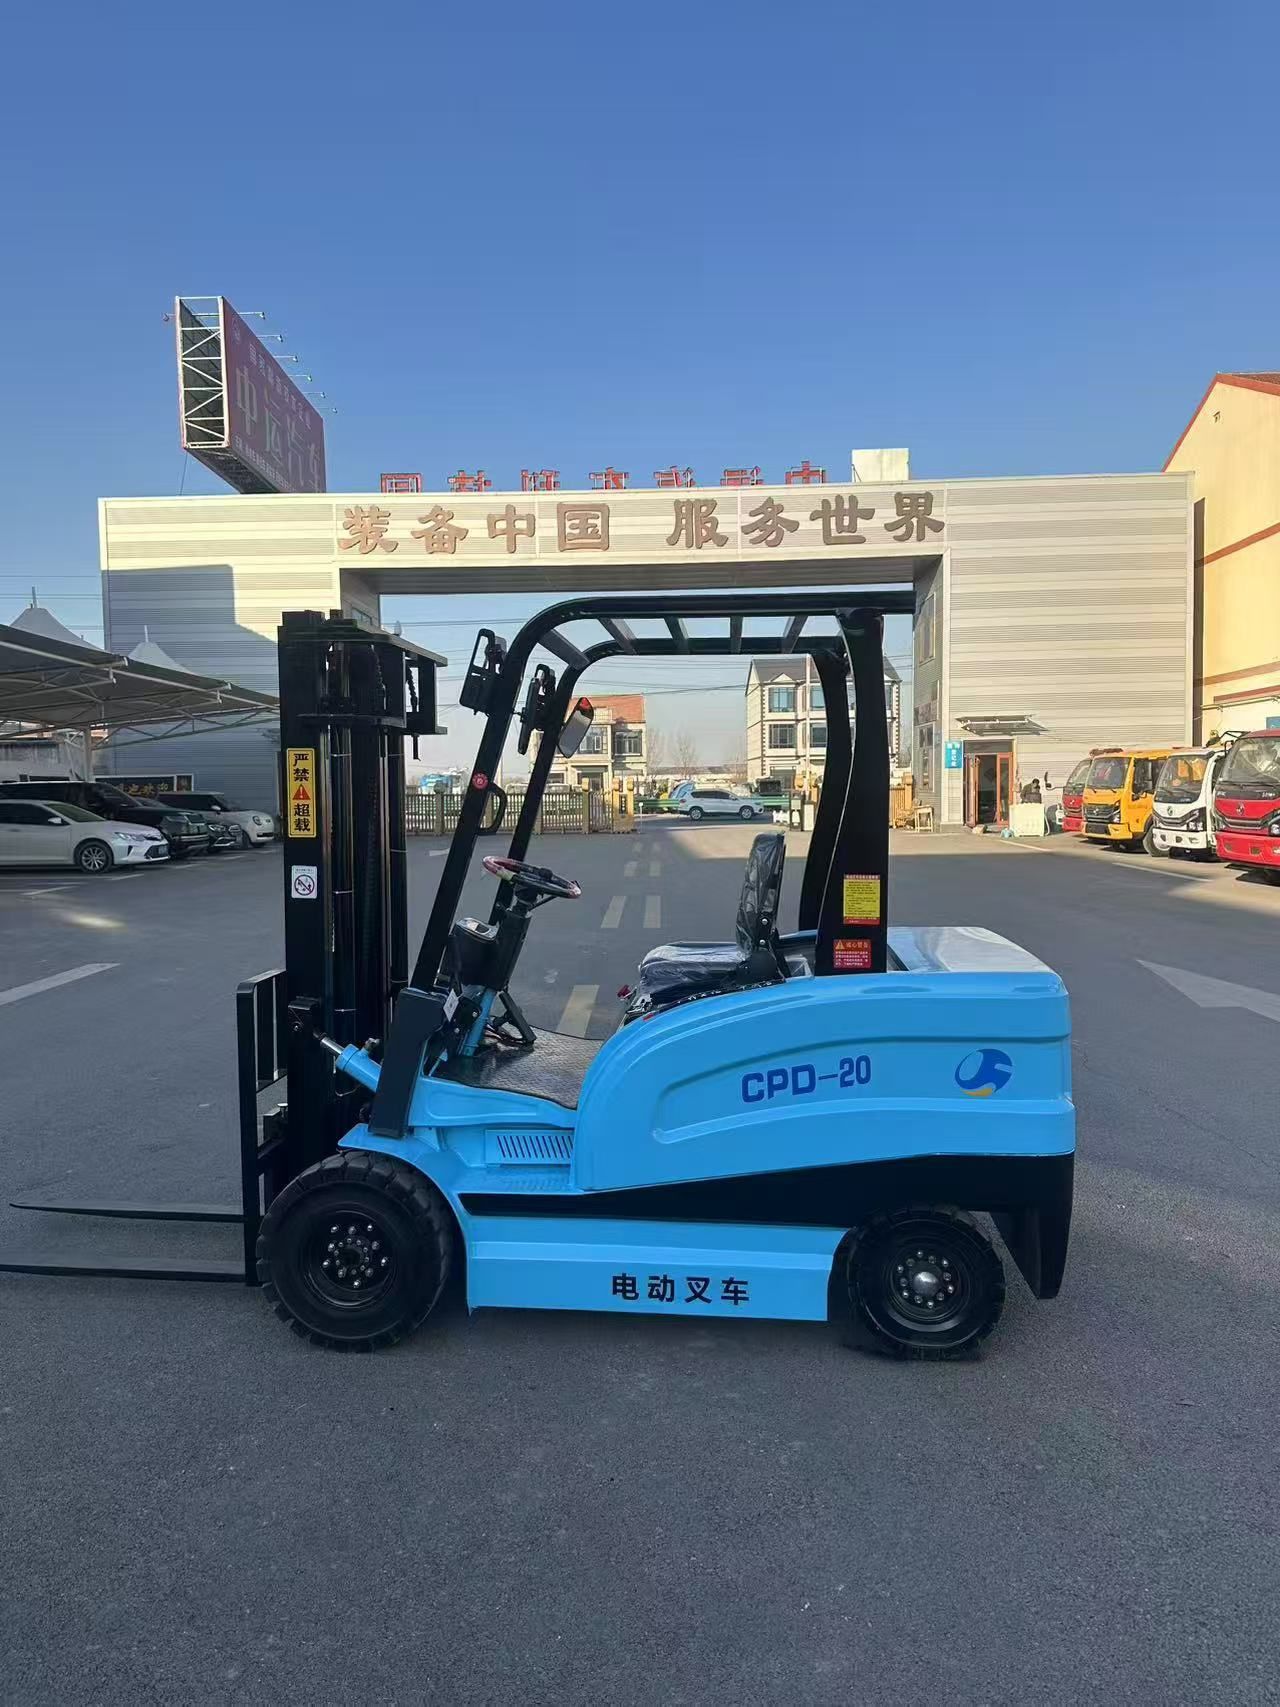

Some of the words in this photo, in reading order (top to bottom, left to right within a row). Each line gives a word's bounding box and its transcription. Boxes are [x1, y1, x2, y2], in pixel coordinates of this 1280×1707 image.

[339, 503, 610, 555] 装备中国
[666, 491, 945, 550] 服务世界
[293, 753, 310, 782] 严禁
[294, 803, 311, 832] 超载
[741, 1054, 872, 1103] CPD-20
[612, 1273, 750, 1306] 电动叉车
